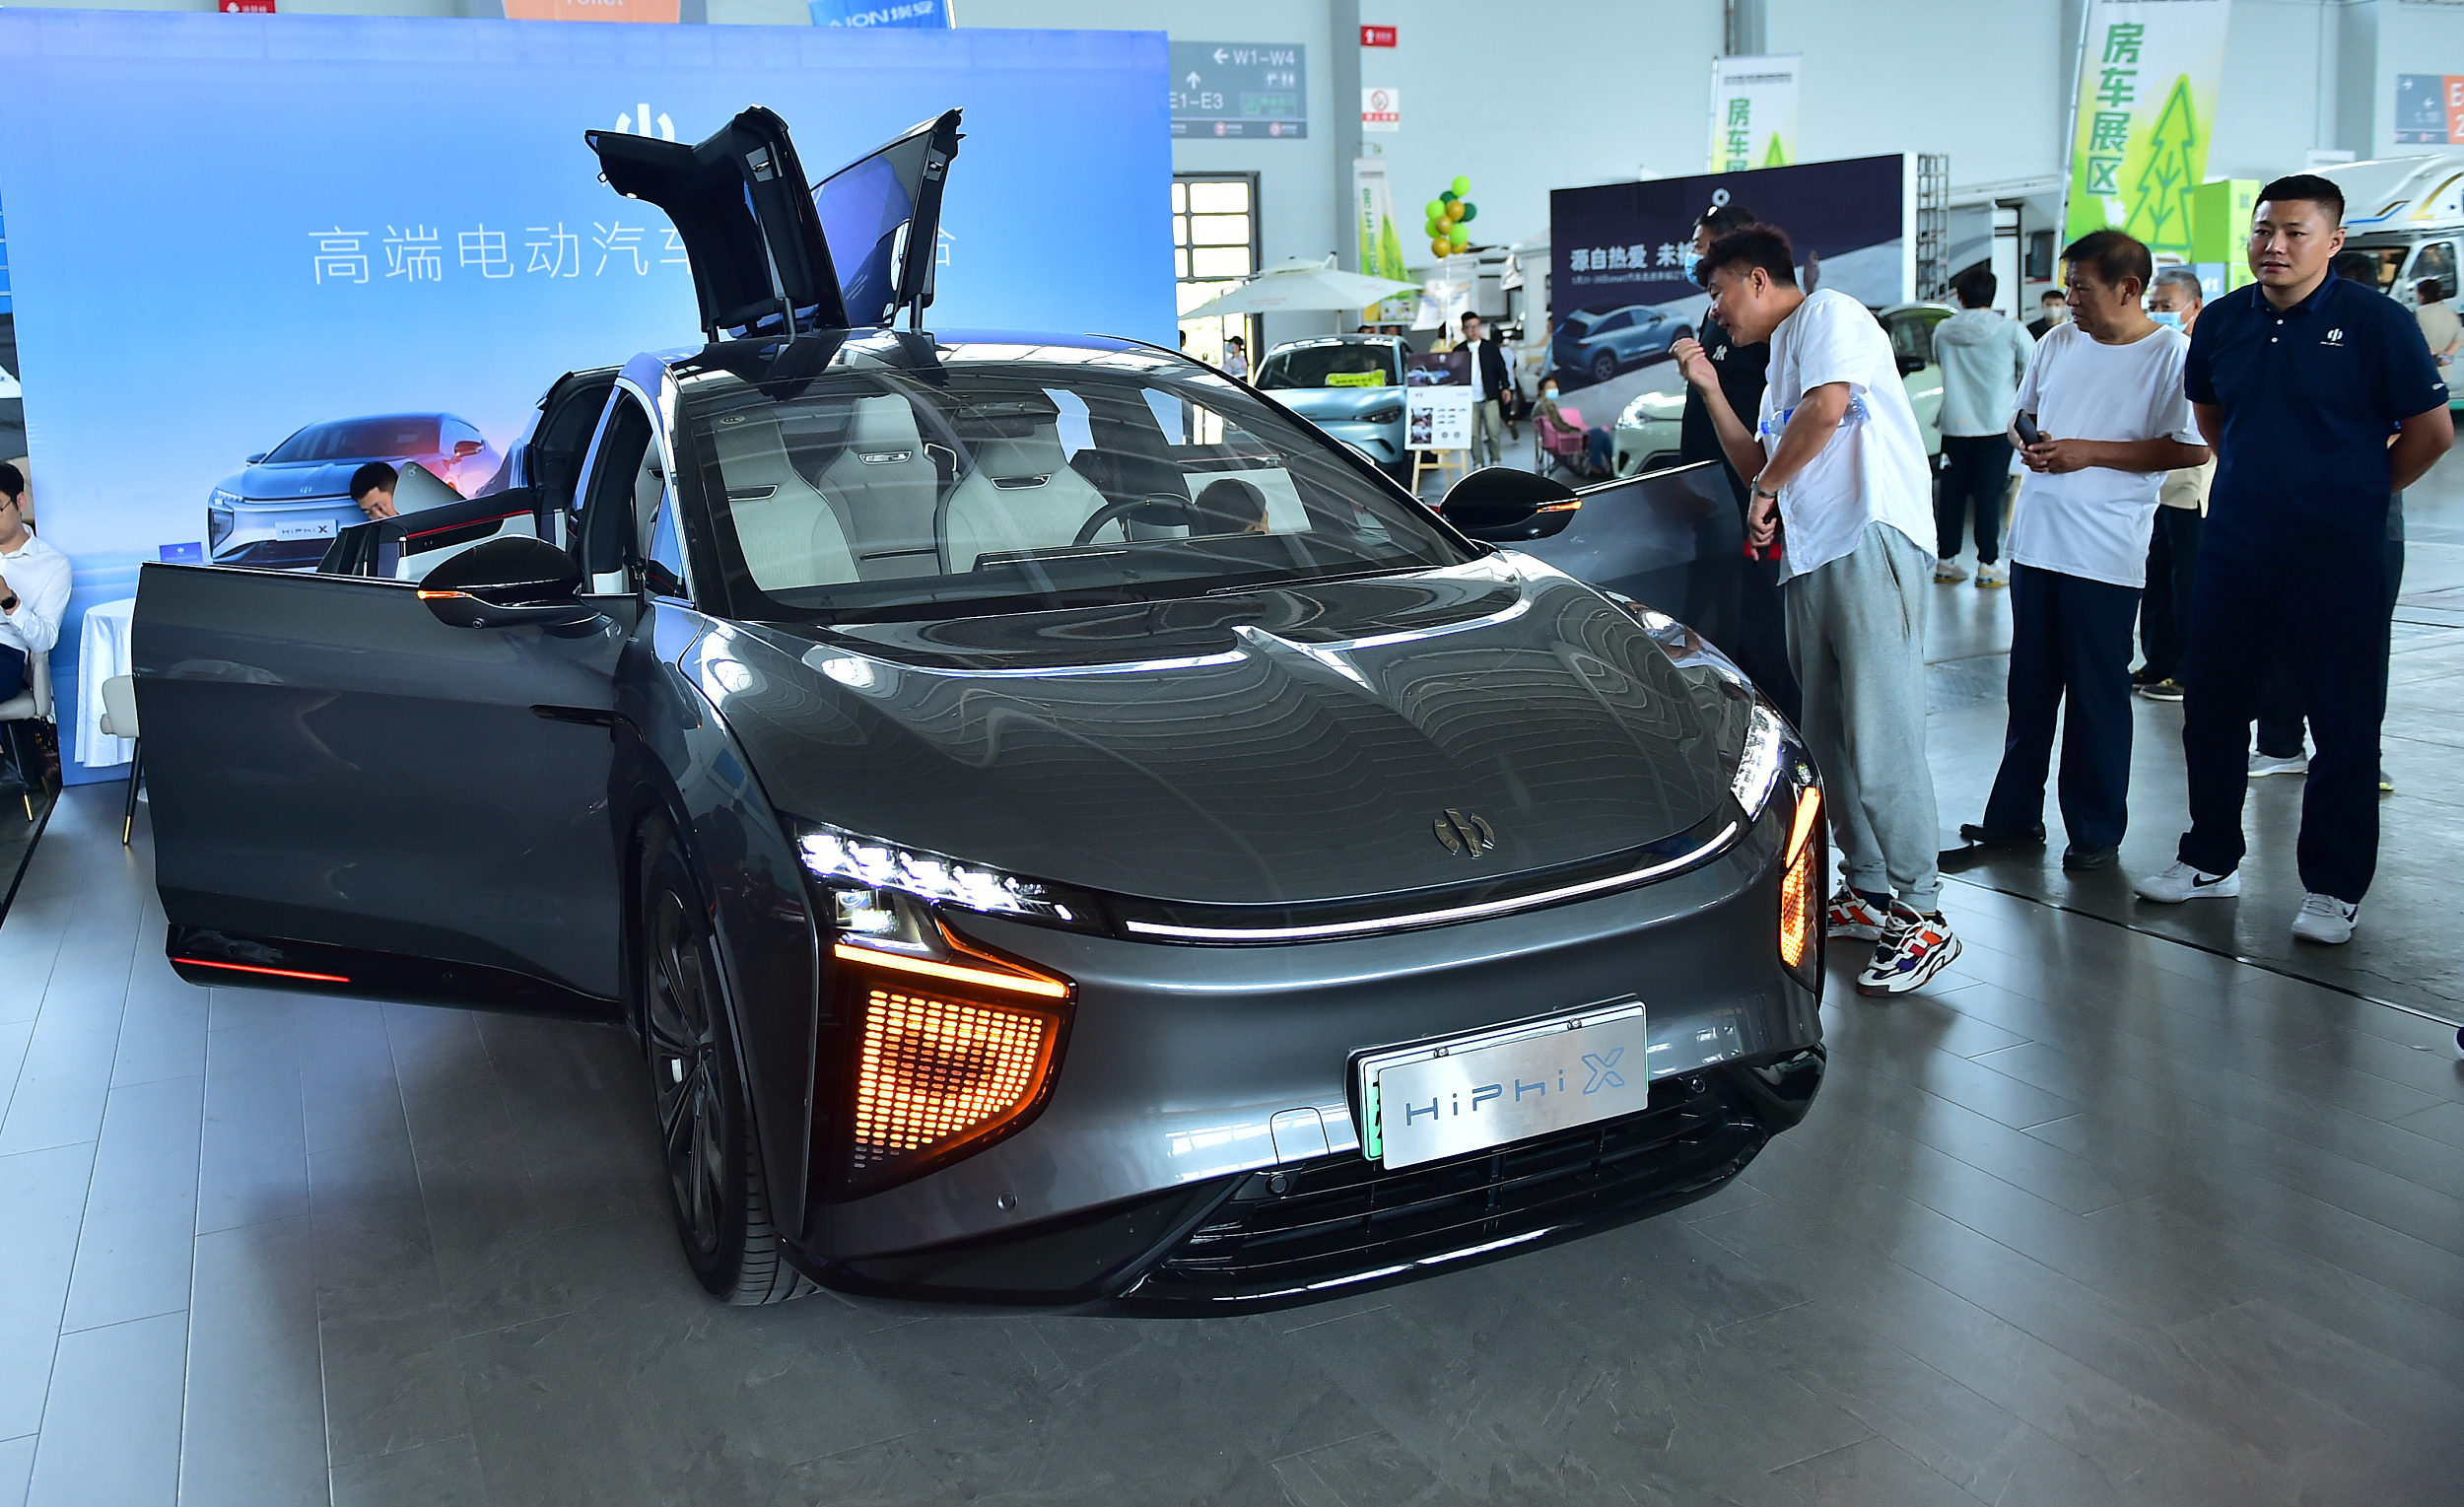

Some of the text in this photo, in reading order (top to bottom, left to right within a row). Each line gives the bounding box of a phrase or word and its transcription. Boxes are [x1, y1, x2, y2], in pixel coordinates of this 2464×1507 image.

[1233, 49, 1296, 66] W1-W4
[1169, 92, 1224, 109] E1-E3
[2087, 23, 2145, 195] 房车展区
[308, 221, 694, 286] 高端电动汽车
[1570, 243, 1648, 272] 源自热爱
[318, 524, 328, 533] X
[1405, 1069, 1564, 1127] HiPhi
[1581, 1047, 1626, 1095] X
